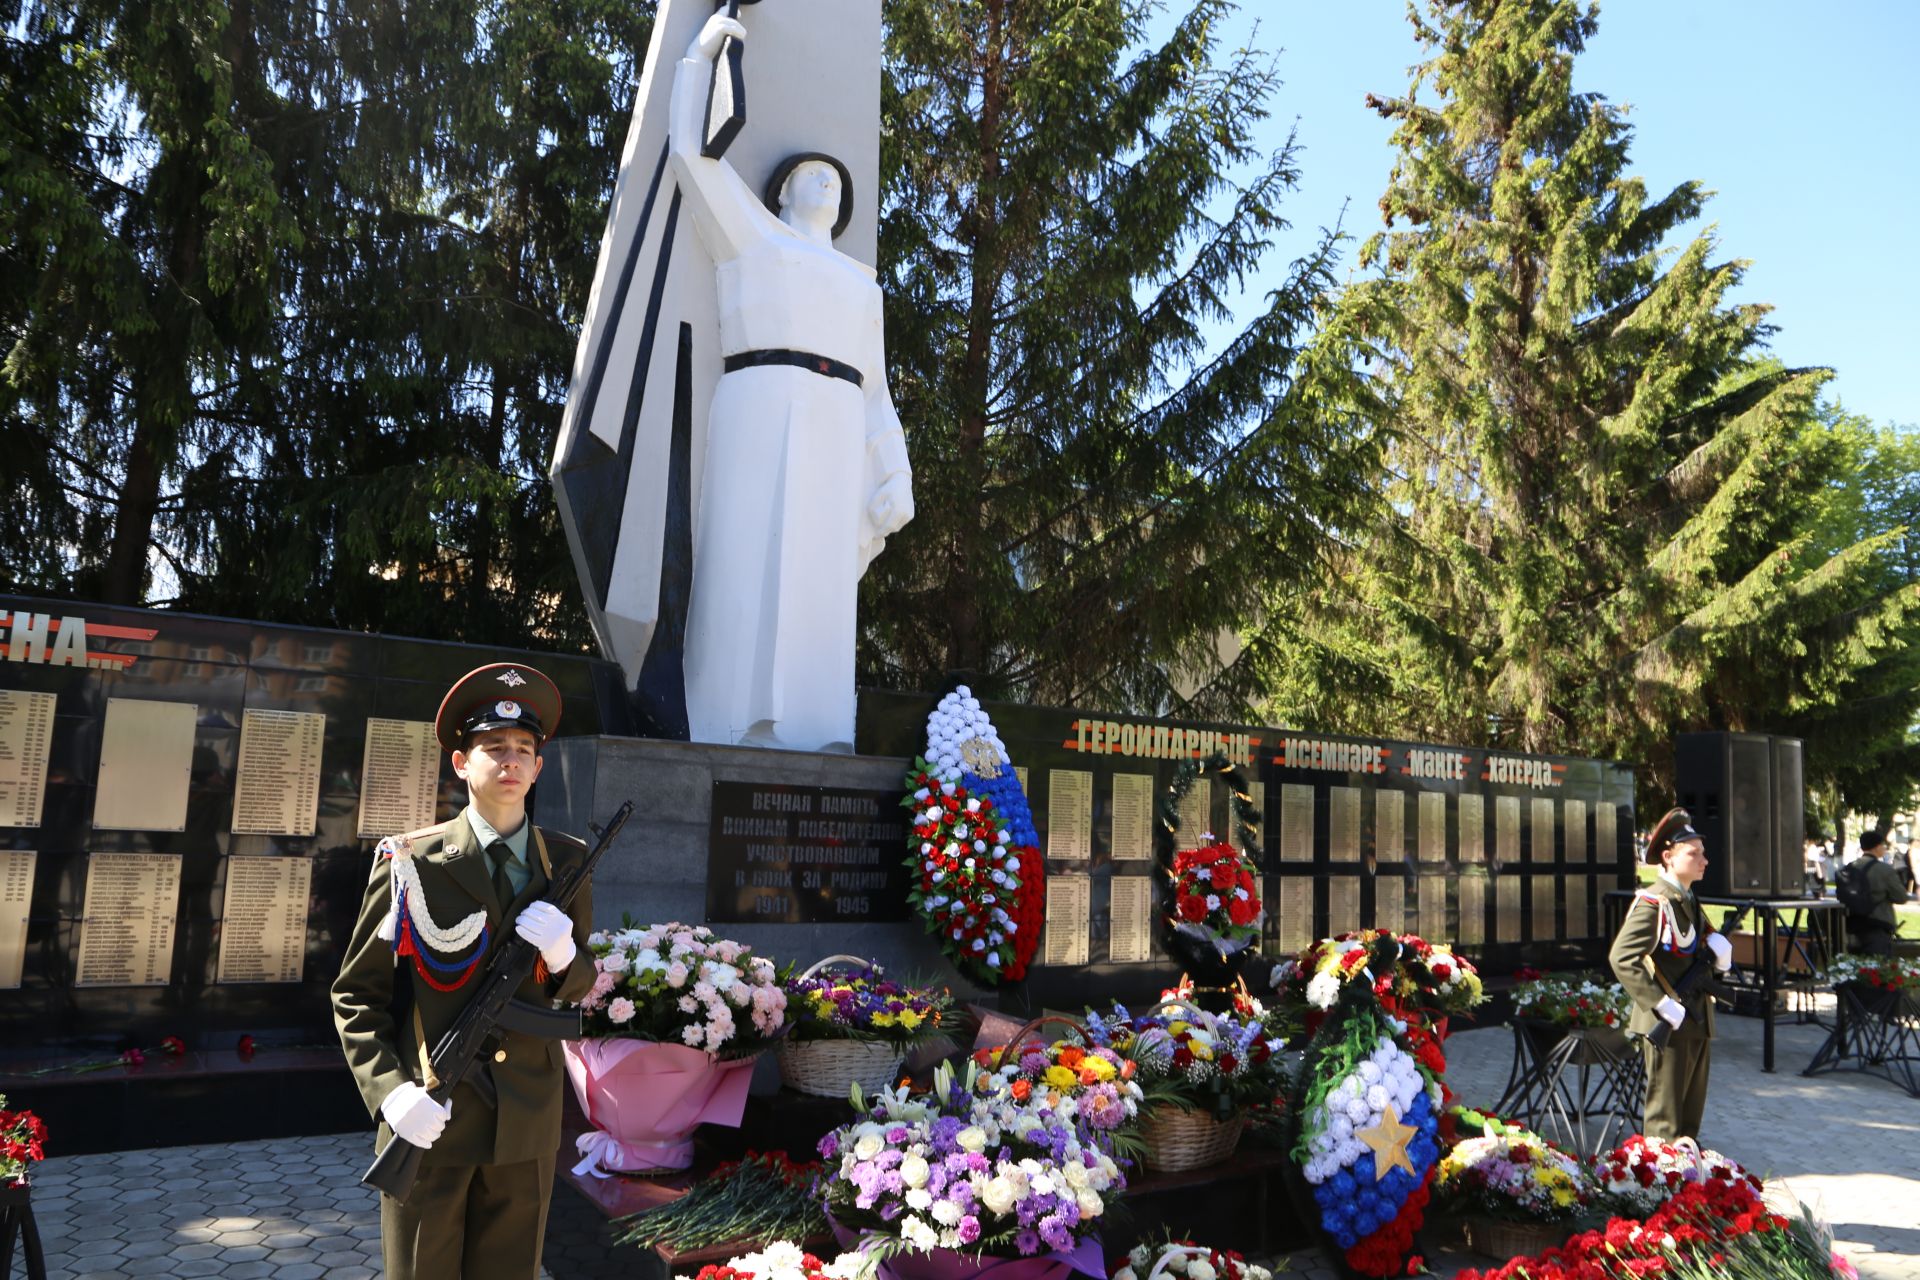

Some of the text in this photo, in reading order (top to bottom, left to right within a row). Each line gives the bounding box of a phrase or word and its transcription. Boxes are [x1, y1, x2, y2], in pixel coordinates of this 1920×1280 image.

[0, 608, 124, 671] НА...
[1284, 738, 1382, 774] ИСЕМНӘРЕ
[1410, 749, 1464, 781] МӘҢГЕ
[752, 792, 879, 816] ВЕЧНАЯ ПАМЯТЬ
[722, 816, 788, 837] ВОИНАМ
[747, 843, 880, 865] УЧАСТВОВАВШИМ
[735, 870, 745, 886] В
[802, 871, 821, 889] ЗА
[831, 871, 888, 890] РОДИНУ
[756, 896, 870, 914] 1941 1945
